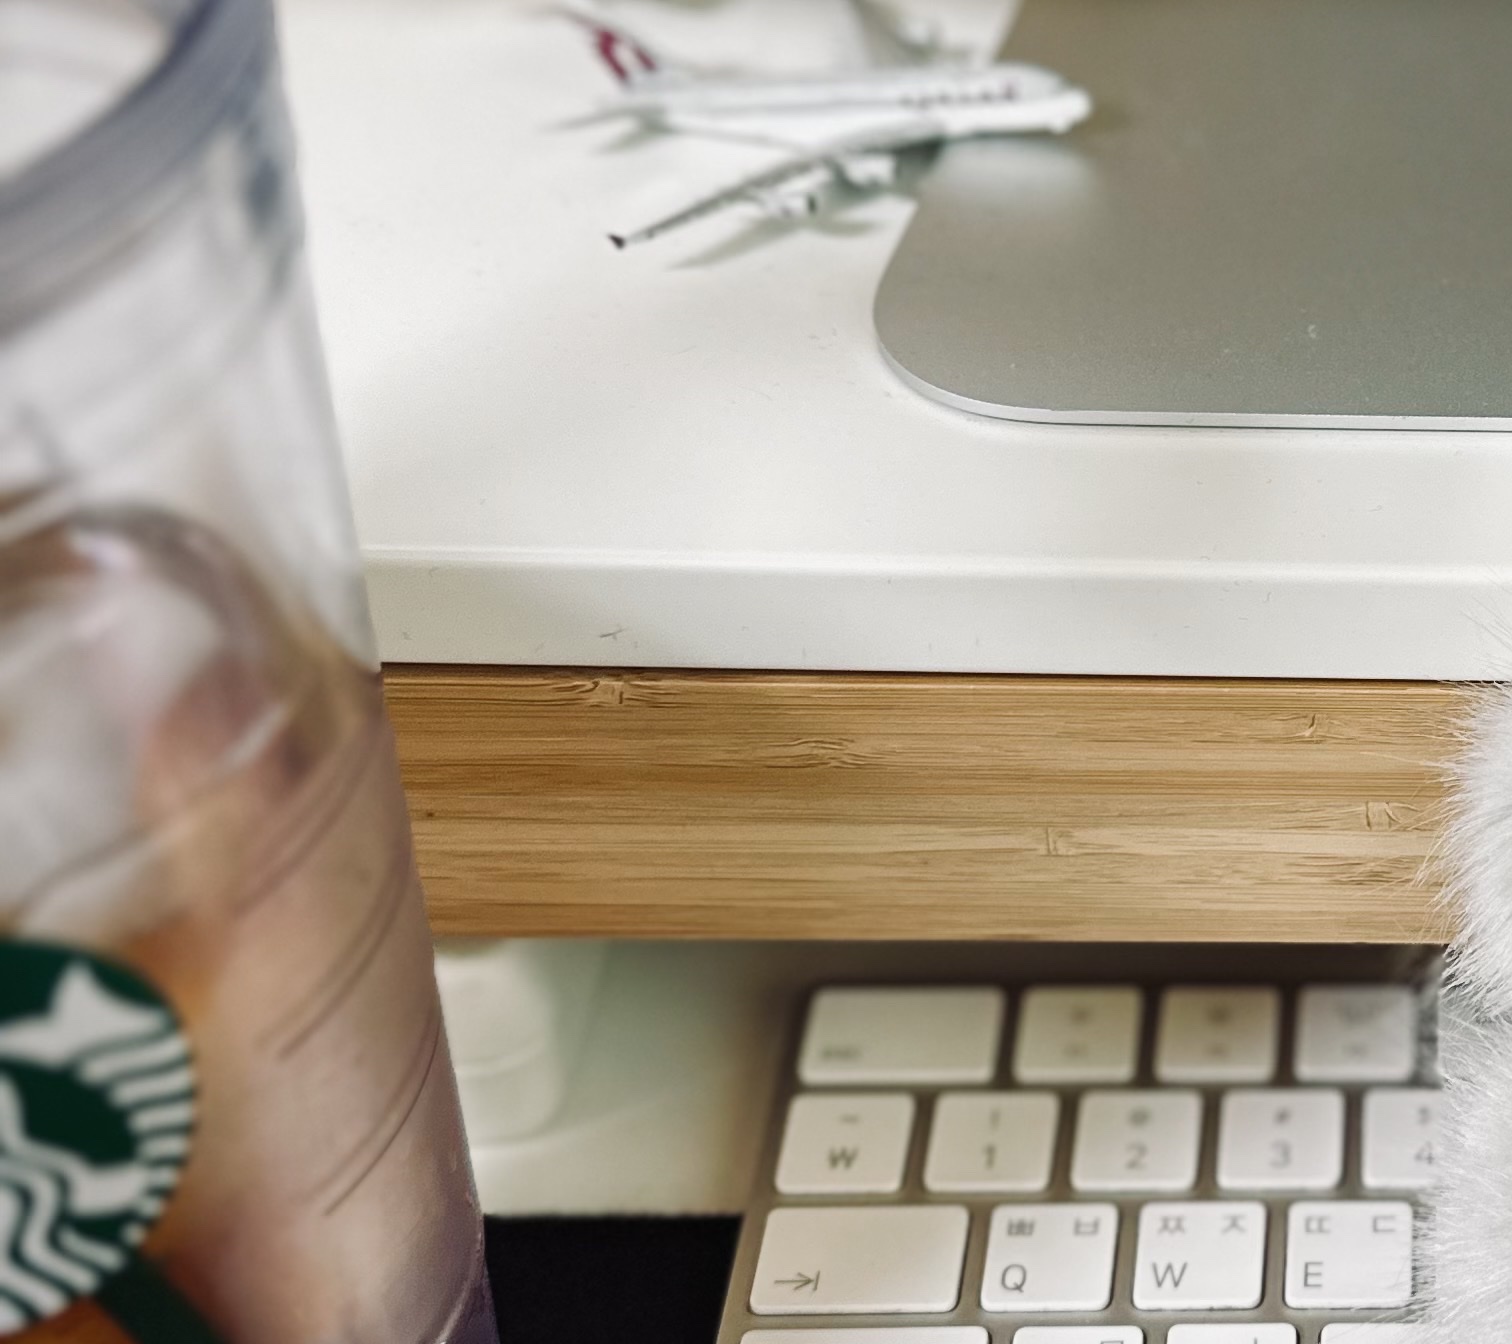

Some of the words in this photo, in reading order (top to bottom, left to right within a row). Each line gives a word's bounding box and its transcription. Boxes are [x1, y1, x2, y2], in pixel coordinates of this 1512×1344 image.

[1124, 1138, 1149, 1171] 2
[1270, 1138, 1293, 1169] 3
[1000, 1263, 1028, 1294] Q
[1151, 1261, 1188, 1289] W
[1302, 1261, 1323, 1289] E
